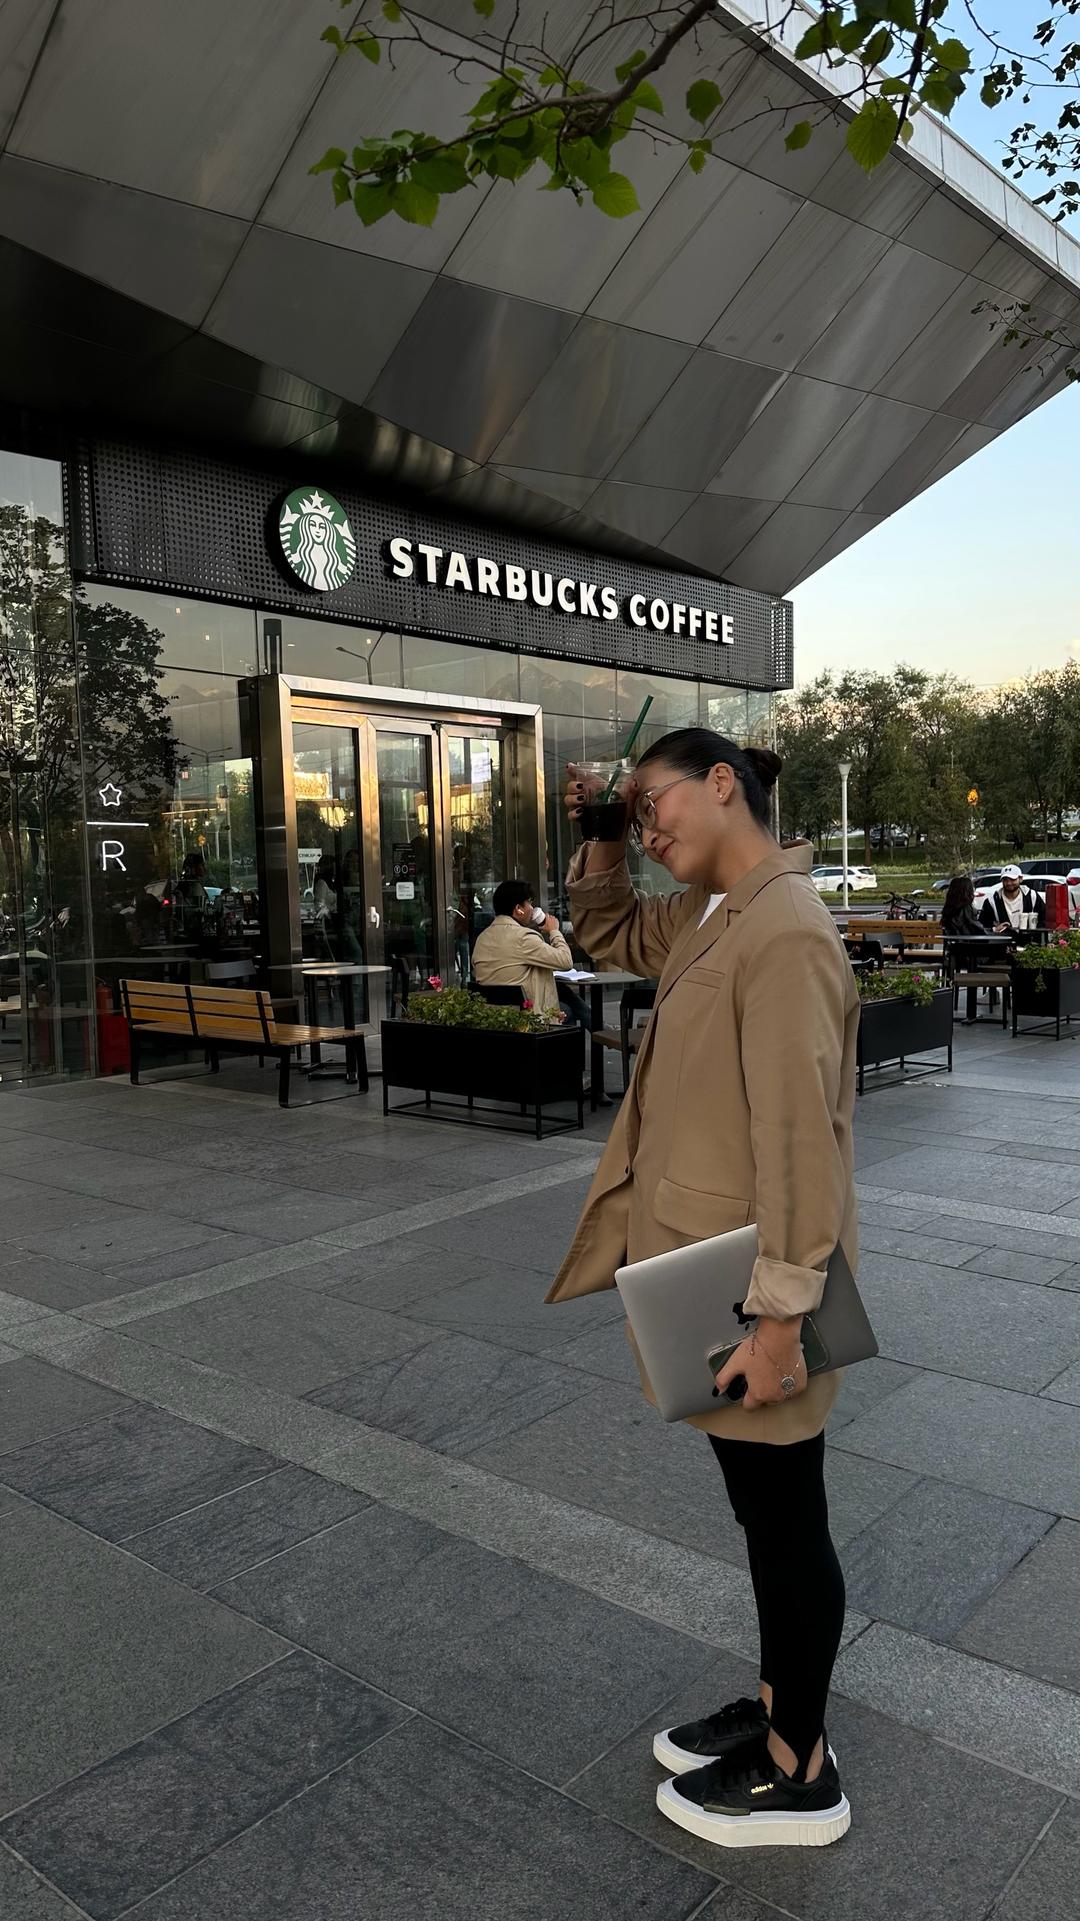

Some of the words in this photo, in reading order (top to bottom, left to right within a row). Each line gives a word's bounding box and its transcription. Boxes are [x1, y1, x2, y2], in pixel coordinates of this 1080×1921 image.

[389, 537, 619, 620] STARBUCKS
[629, 594, 735, 645] COFFEE
[102, 840, 127, 871] R
